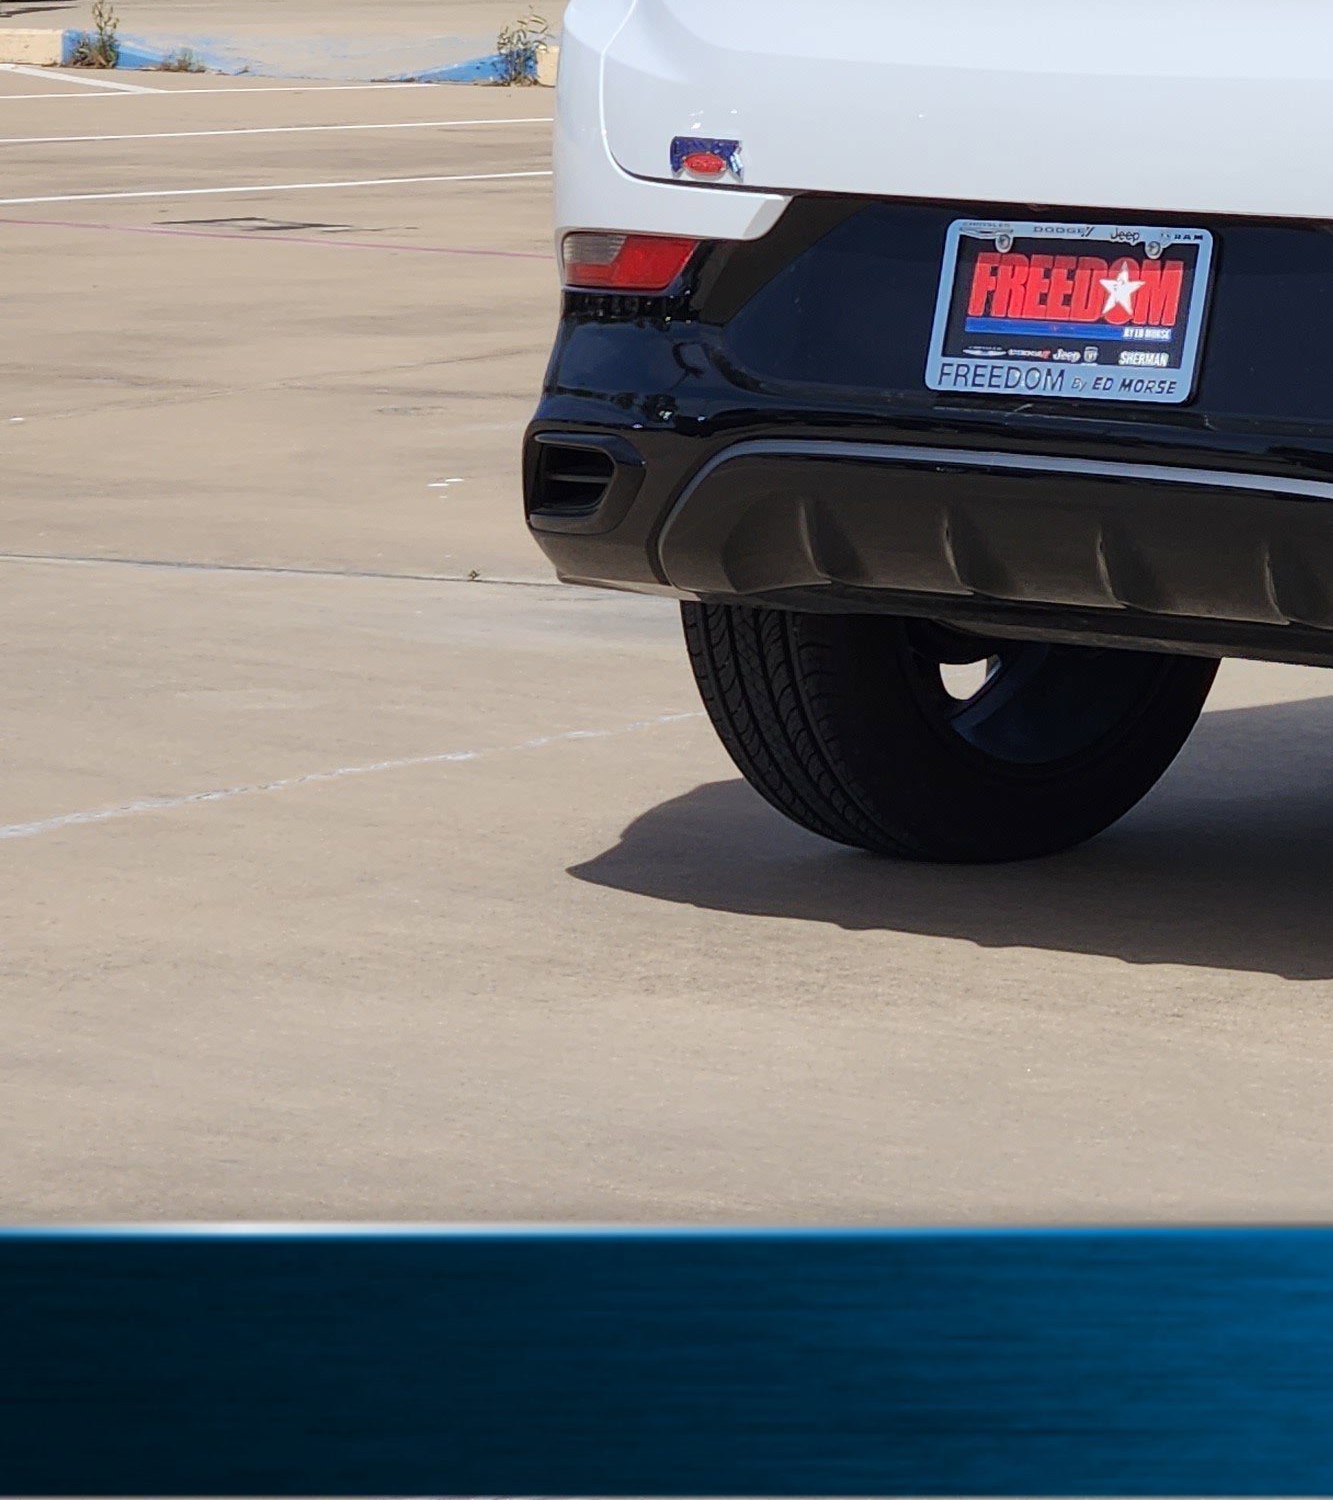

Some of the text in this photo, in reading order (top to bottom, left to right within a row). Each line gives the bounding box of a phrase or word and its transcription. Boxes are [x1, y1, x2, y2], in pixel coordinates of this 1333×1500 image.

[1110, 228, 1141, 243] Jeep
[1173, 233, 1205, 241] RAM
[967, 251, 1184, 327] FREEDOM
[1052, 348, 1082, 363] Jeep
[1118, 350, 1170, 367] SHERMAN
[938, 363, 1065, 393] FREEDOM
[1092, 376, 1115, 392] ED
[1118, 377, 1178, 395] MORSE
